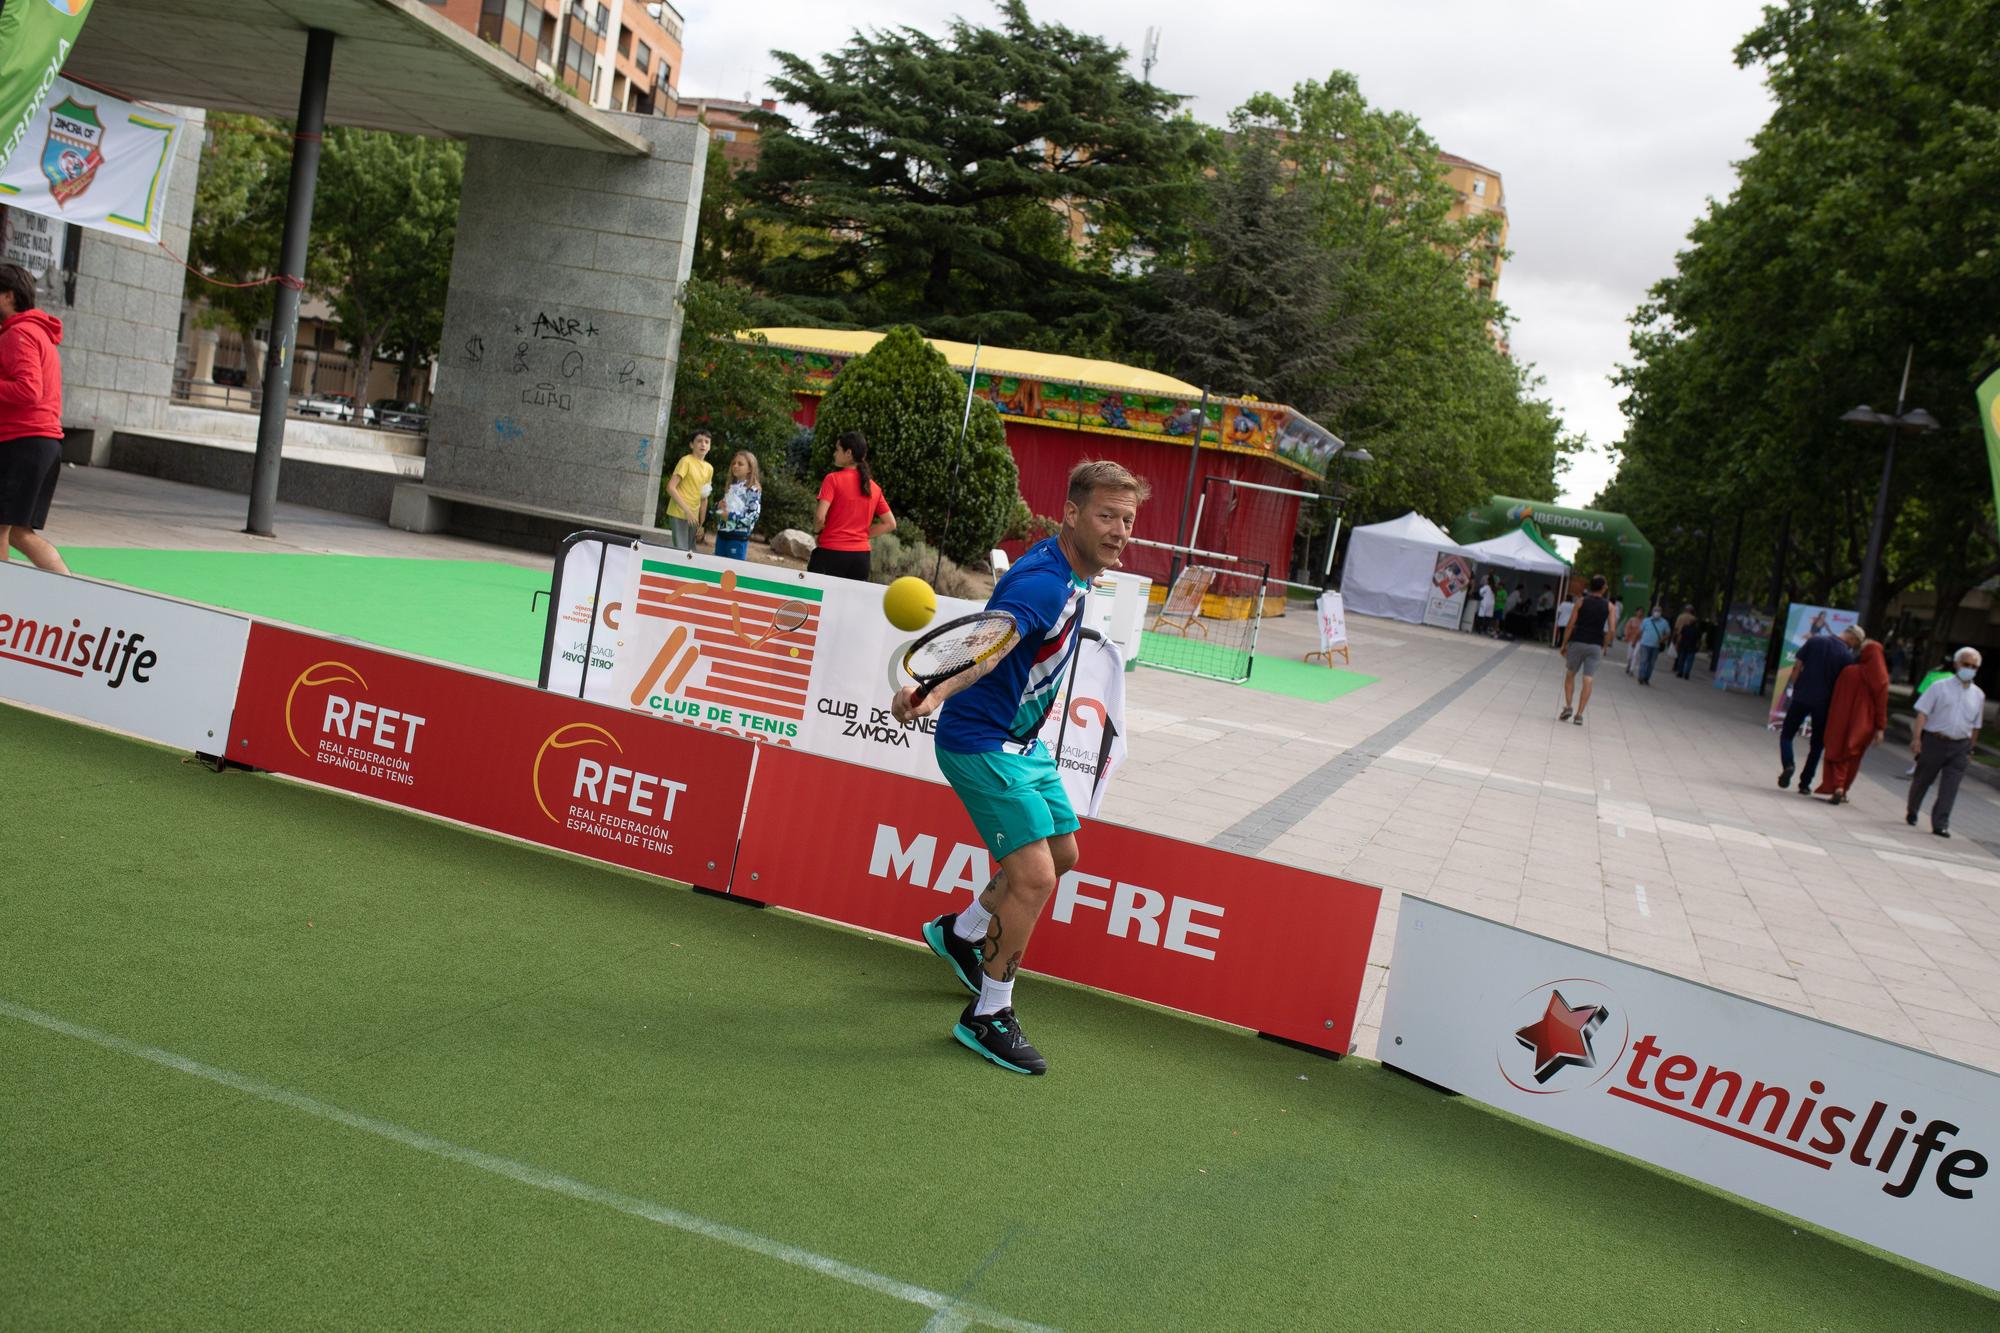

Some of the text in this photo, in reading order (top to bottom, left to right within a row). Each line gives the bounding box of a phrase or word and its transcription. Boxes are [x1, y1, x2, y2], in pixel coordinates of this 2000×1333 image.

[1533, 511, 1605, 532] IBERDROLA
[322, 694, 426, 754] RFET
[649, 695, 700, 717] CLUB
[707, 706, 732, 724] DE
[739, 713, 798, 737] TENIS
[817, 698, 858, 719] CLUB
[870, 707, 890, 726] DE
[842, 720, 910, 748] ZAMORA
[317, 752, 414, 785] ESPAÑOLA DE TENIS
[319, 740, 410, 771] REAL FEDERACIÓN
[572, 758, 688, 822] RFET
[567, 818, 673, 855] ESPAÑOLA DE TENIS
[569, 805, 669, 840] REAL FEDERACIÓN
[868, 823, 1225, 961] MAFRE
[1625, 1034, 1989, 1200] tennislife
